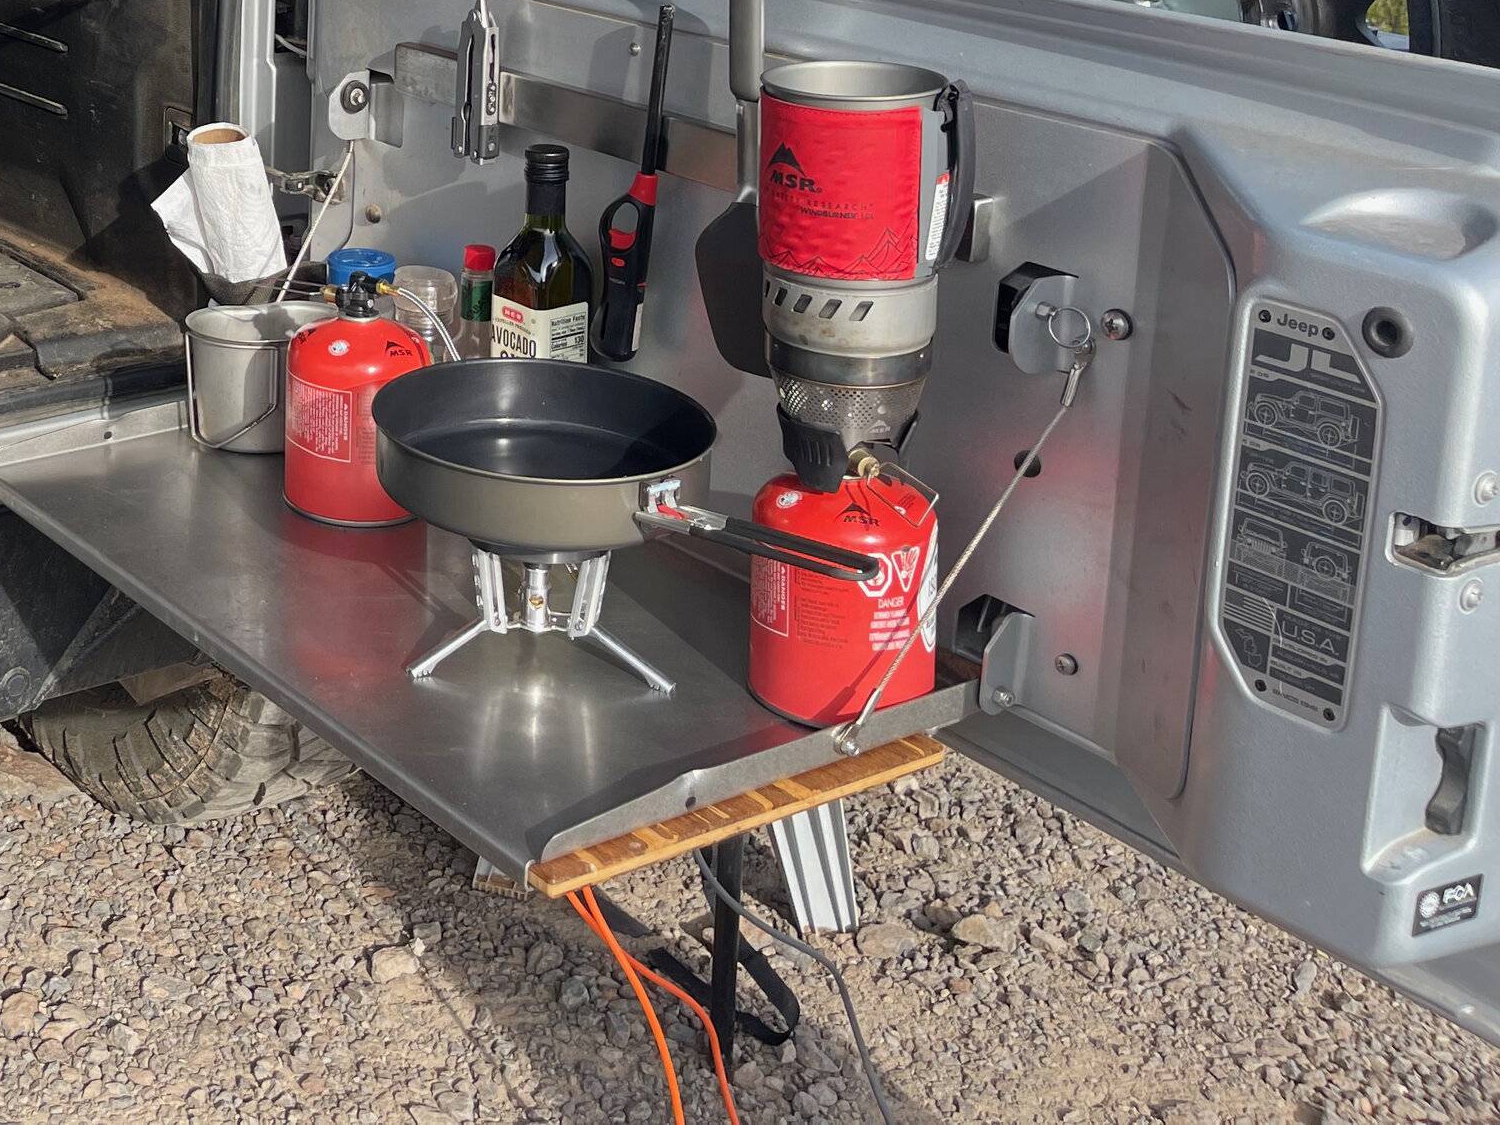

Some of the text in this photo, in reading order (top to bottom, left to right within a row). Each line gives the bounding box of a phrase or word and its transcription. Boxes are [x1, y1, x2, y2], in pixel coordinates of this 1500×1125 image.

[770, 170, 817, 194] MSR
[1277, 313, 1319, 337] Jeep
[390, 349, 412, 357] MSR
[491, 324, 537, 358] AVOCADO
[1255, 343, 1361, 384] JL
[843, 515, 881, 527] MSR
[877, 596, 904, 609] DANGER
[1281, 619, 1340, 656] U.S.A.
